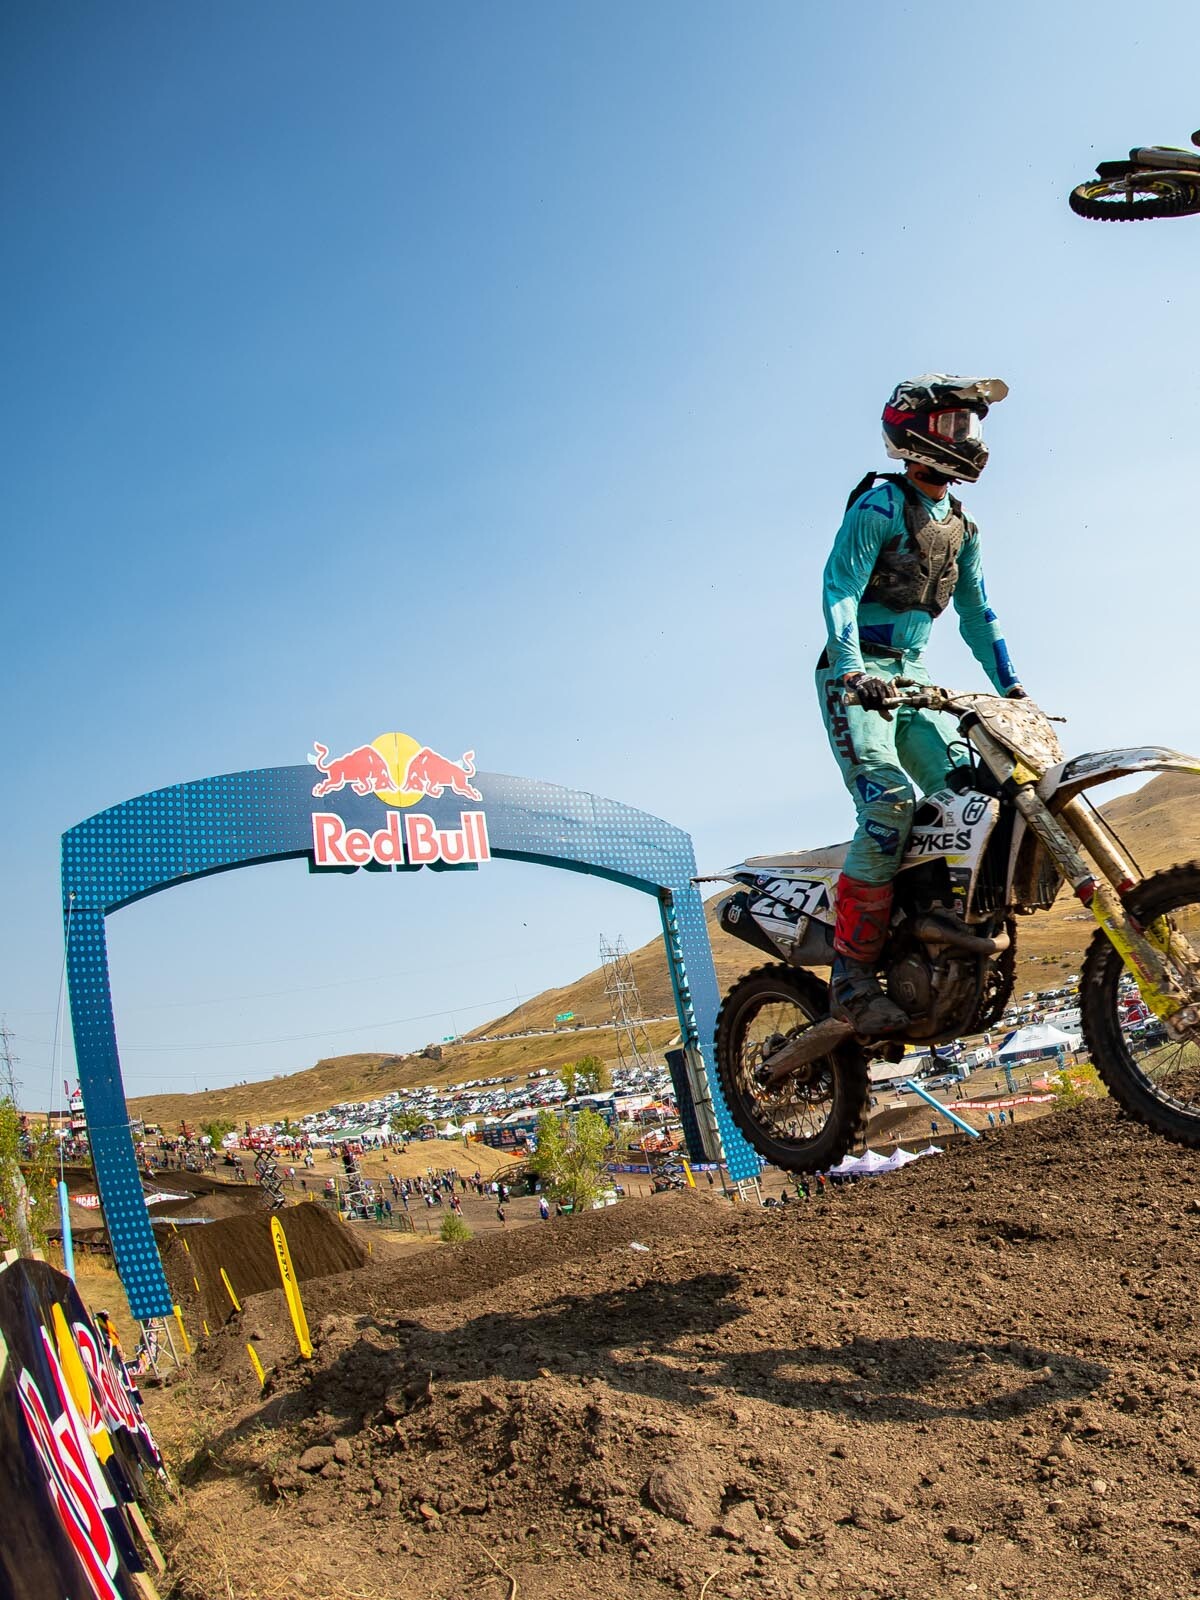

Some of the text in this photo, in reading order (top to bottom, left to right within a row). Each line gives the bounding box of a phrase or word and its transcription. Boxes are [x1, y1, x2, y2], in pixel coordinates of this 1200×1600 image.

[825, 679, 860, 765] LEATT
[313, 811, 490, 865] Red Bull
[750, 879, 827, 920] 251
[274, 1232, 292, 1282] ACERBIS
